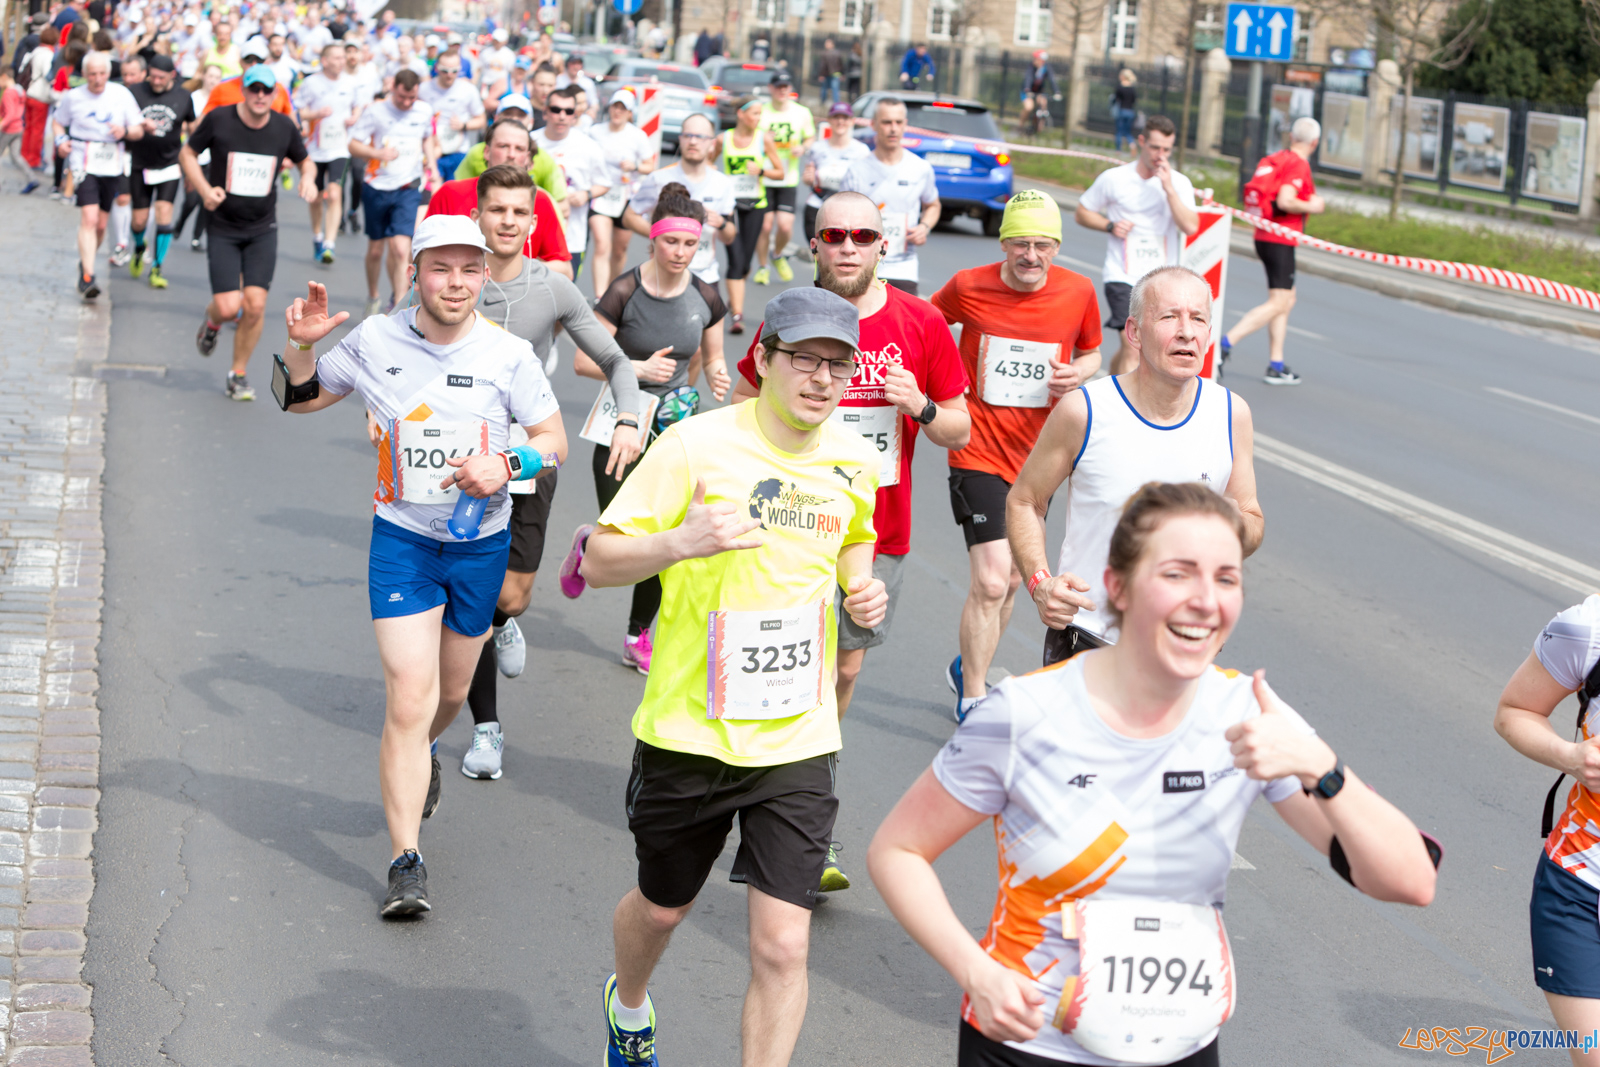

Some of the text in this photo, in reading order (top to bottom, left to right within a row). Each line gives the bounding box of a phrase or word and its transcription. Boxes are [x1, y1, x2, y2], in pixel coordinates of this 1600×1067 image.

[853, 351, 888, 363] YNA
[386, 366, 403, 376] 4F
[994, 360, 1045, 380] 4338
[450, 377, 472, 386] 11.PKO
[781, 491, 816, 505] WINGS
[785, 501, 804, 511] LIFE
[768, 507, 842, 534] WORLD RUN
[741, 639, 812, 674] 3233
[766, 677, 794, 687] Witold
[1067, 774, 1098, 788] 4F
[1103, 956, 1213, 997] 11994
[1120, 1004, 1187, 1017] Magdalena
